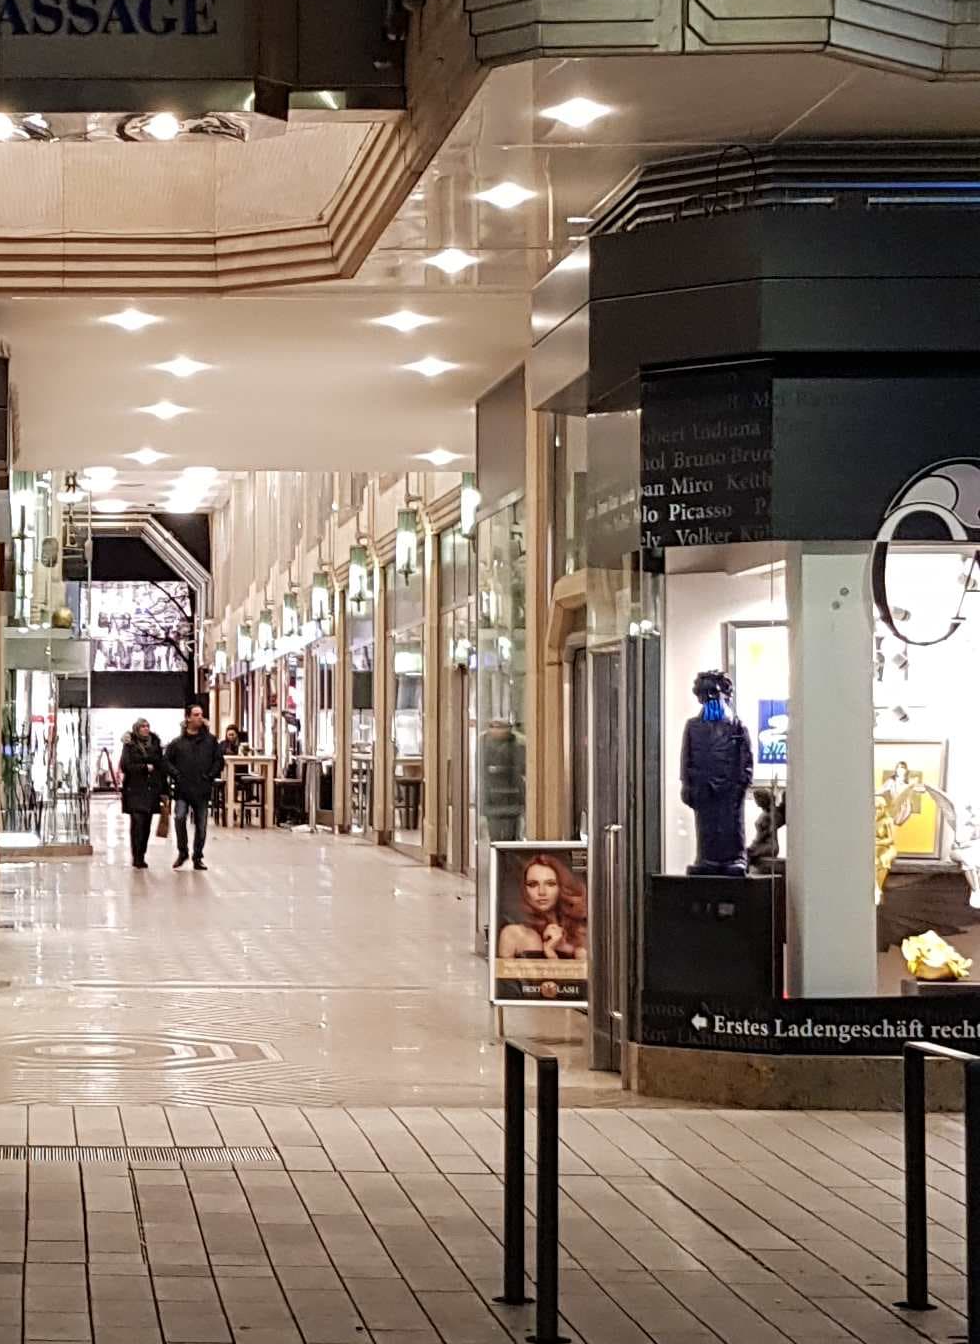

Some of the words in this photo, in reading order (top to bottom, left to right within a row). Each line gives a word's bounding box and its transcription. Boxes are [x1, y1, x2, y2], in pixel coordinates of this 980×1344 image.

[670, 476, 714, 496] Miro
[668, 502, 733, 522] Picasso
[674, 526, 732, 547] Volker
[713, 1014, 769, 1037] Erstes
[774, 1018, 924, 1043] Ladengeschäft
